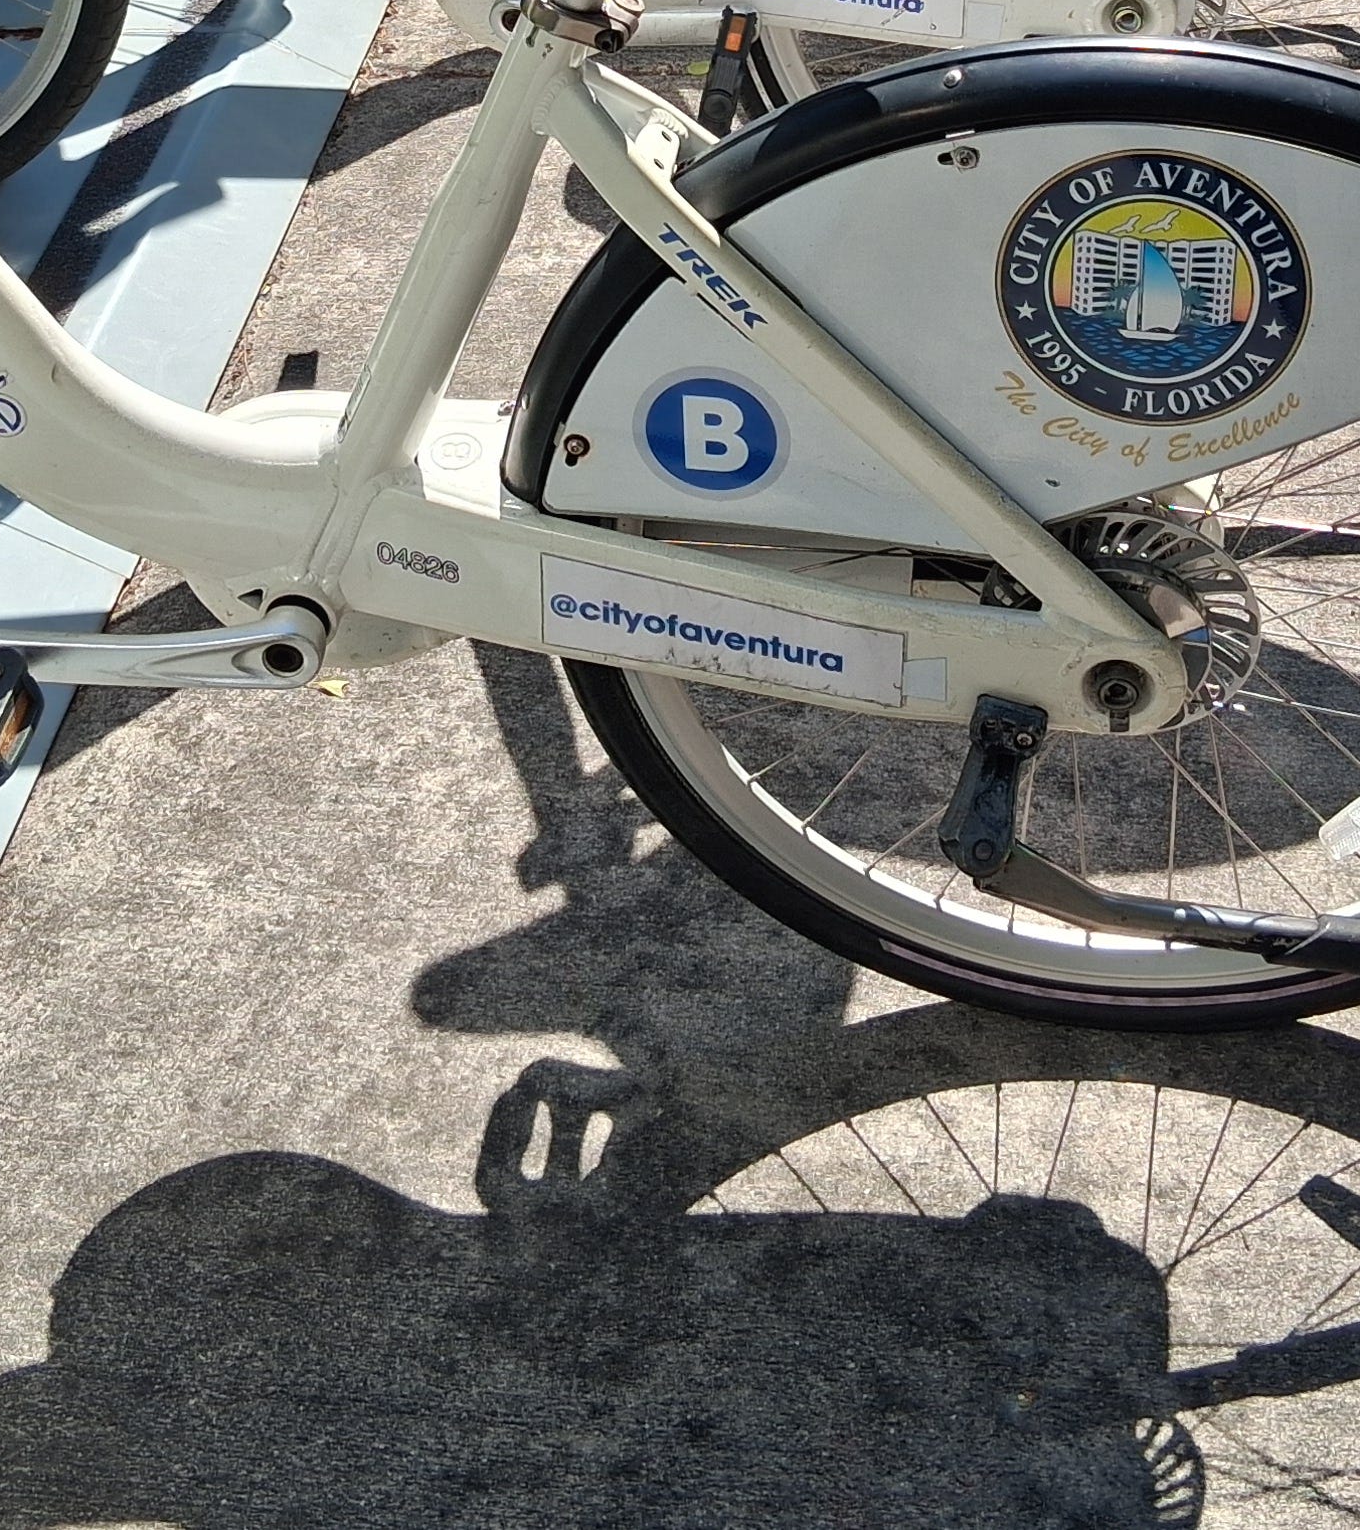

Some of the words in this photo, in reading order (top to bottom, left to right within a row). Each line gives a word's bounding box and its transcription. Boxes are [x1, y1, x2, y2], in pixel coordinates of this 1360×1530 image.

[657, 223, 769, 330] TREK
[1009, 201, 1066, 286] CITY
[1068, 166, 1118, 206] OF
[1133, 161, 1299, 303] AVENTURA
[1024, 329, 1090, 387] 1995
[1120, 349, 1277, 418] FLORIDA
[682, 393, 750, 474] B
[994, 369, 1038, 417] The
[1042, 415, 1110, 457] City
[1120, 437, 1151, 468] of
[1167, 390, 1303, 464] Excellence
[376, 541, 460, 584] 04826
[550, 593, 844, 674] @cityofaventura
